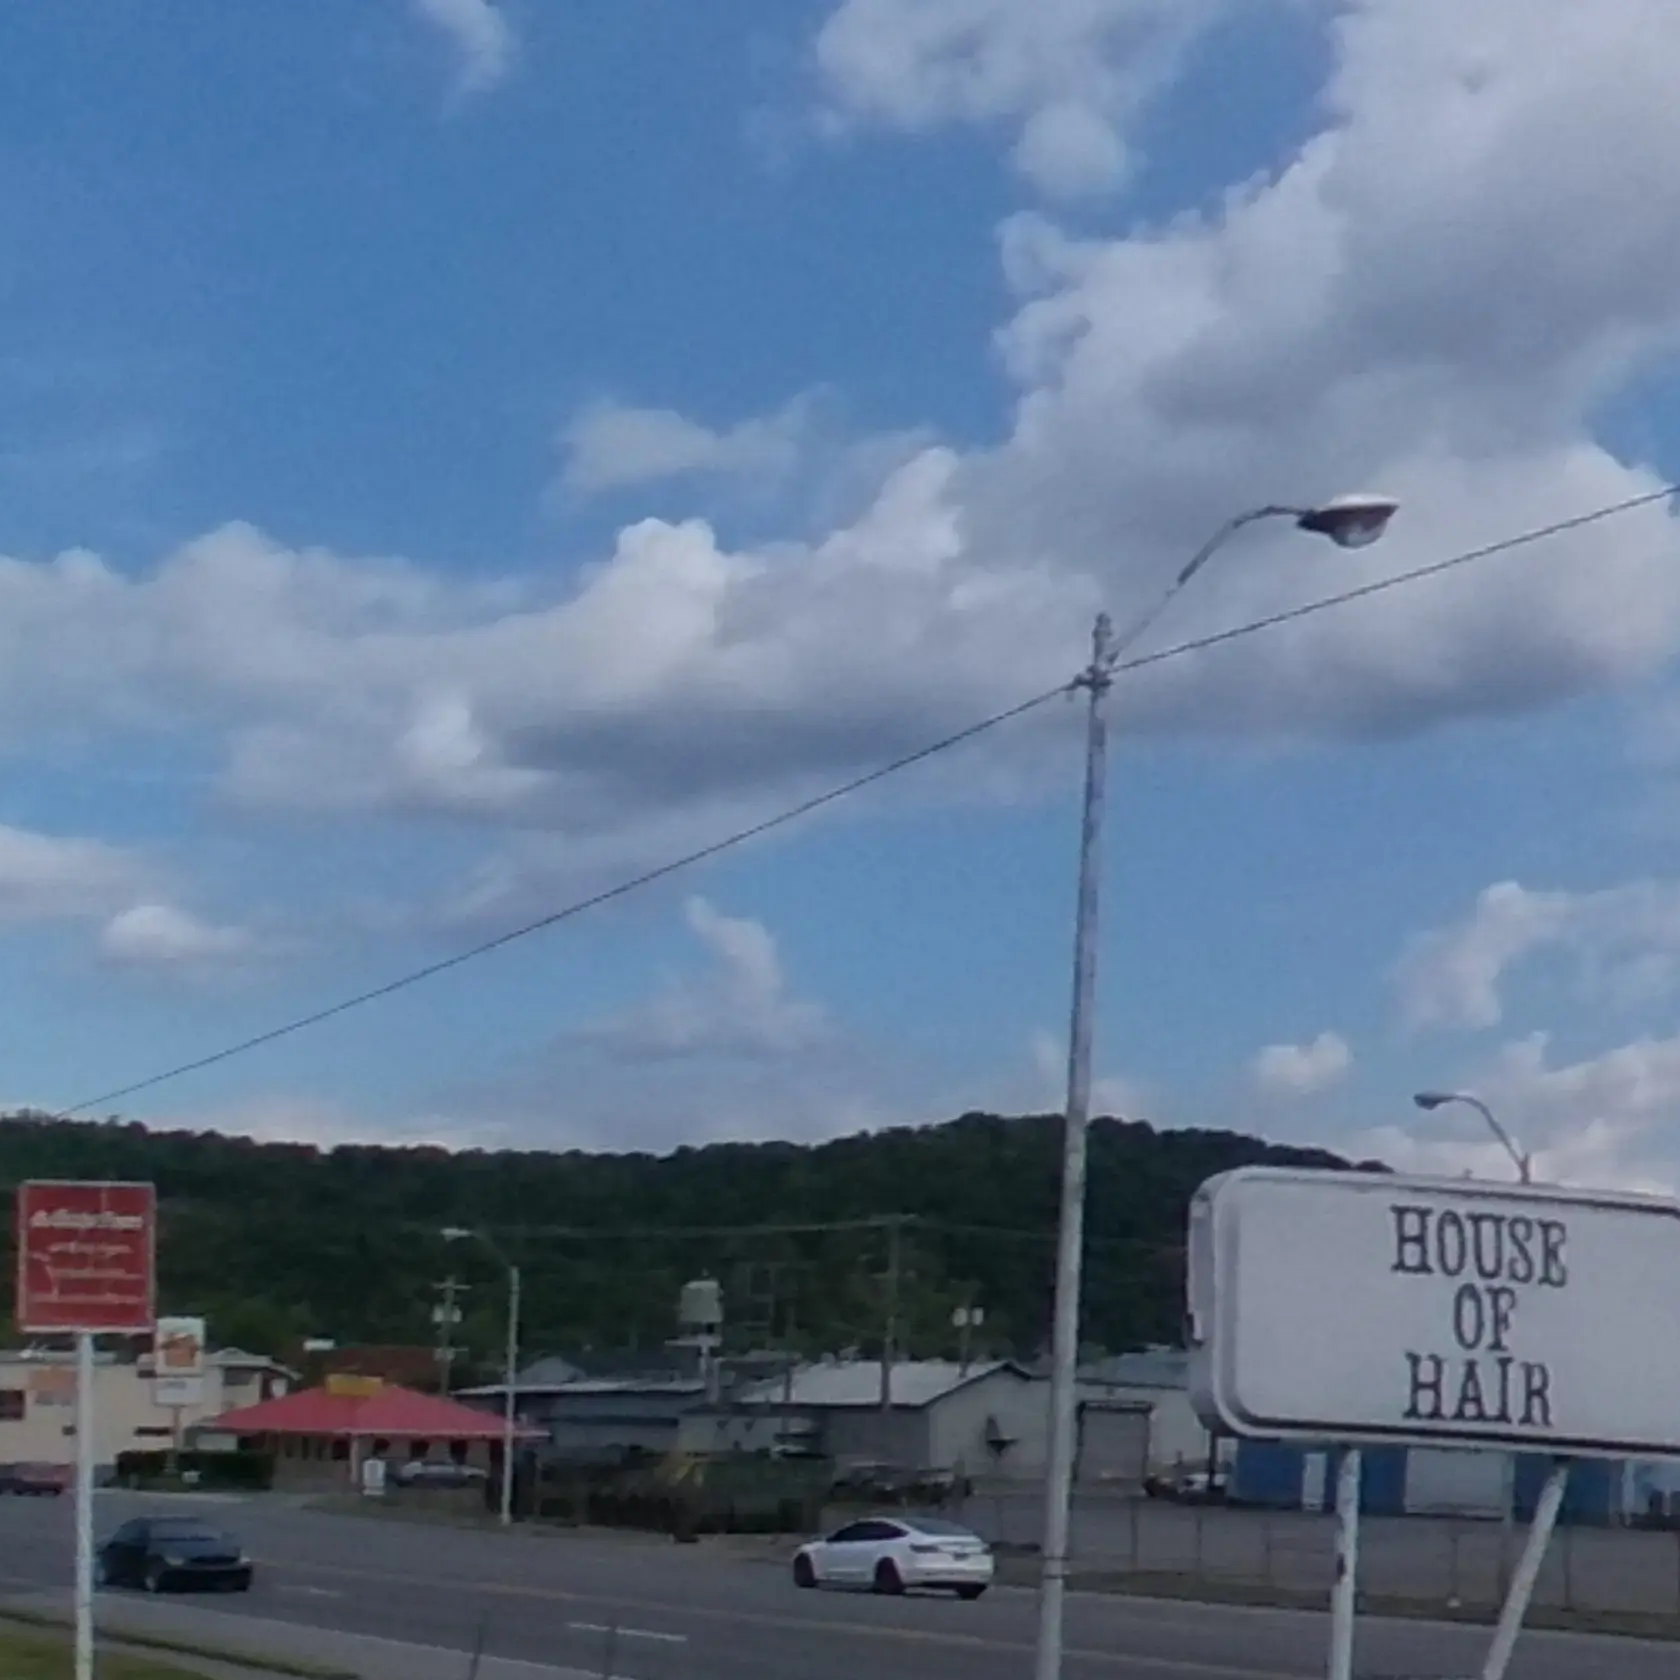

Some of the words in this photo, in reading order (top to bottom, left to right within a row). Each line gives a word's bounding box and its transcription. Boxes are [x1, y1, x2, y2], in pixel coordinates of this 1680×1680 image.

[1390, 1204, 1568, 1288] HOUSE
[1453, 1283, 1518, 1351] OF
[1403, 1351, 1552, 1427] HAIR
